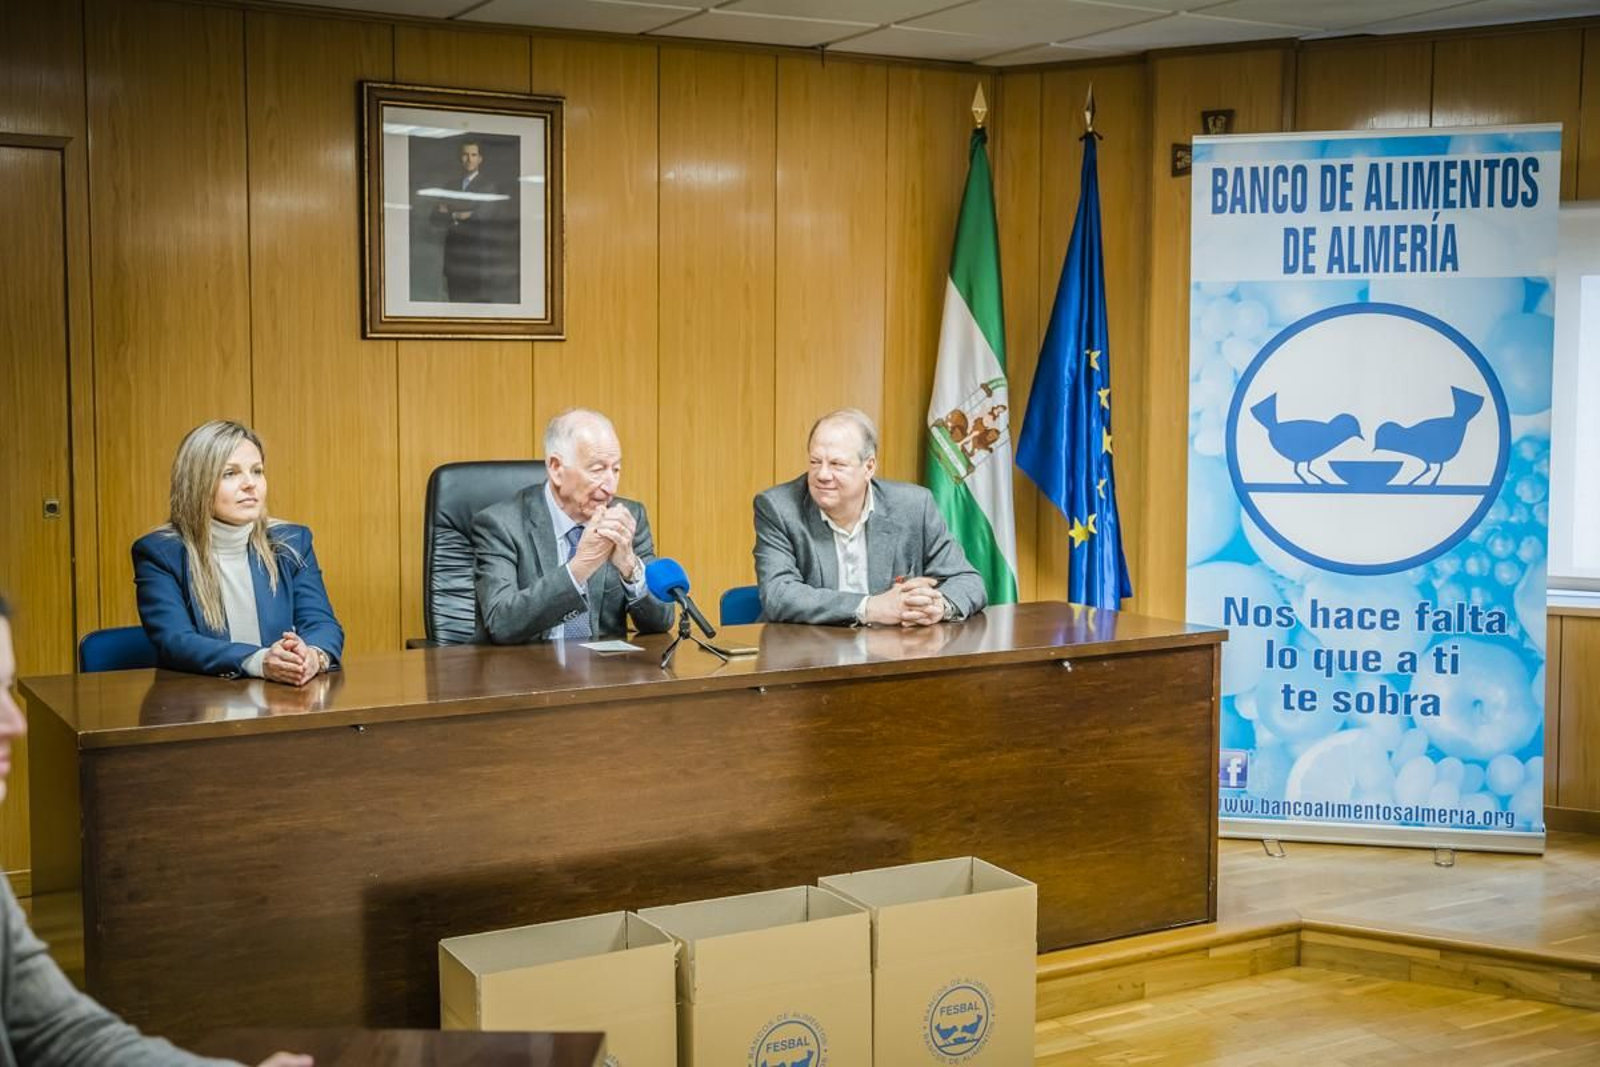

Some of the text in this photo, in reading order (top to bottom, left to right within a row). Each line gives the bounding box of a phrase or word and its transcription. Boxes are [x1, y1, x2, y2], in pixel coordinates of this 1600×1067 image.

[1211, 156, 1540, 215] BANCO DE ALIMENTOS
[1283, 211, 1459, 274] DE ALMERÍA
[1223, 596, 1507, 634] Nos hace falta
[1265, 640, 1460, 678] lo que a ti
[1281, 683, 1441, 717] te sobra
[938, 1001, 981, 1017] FESBAL
[765, 1035, 811, 1054] FESBAL
